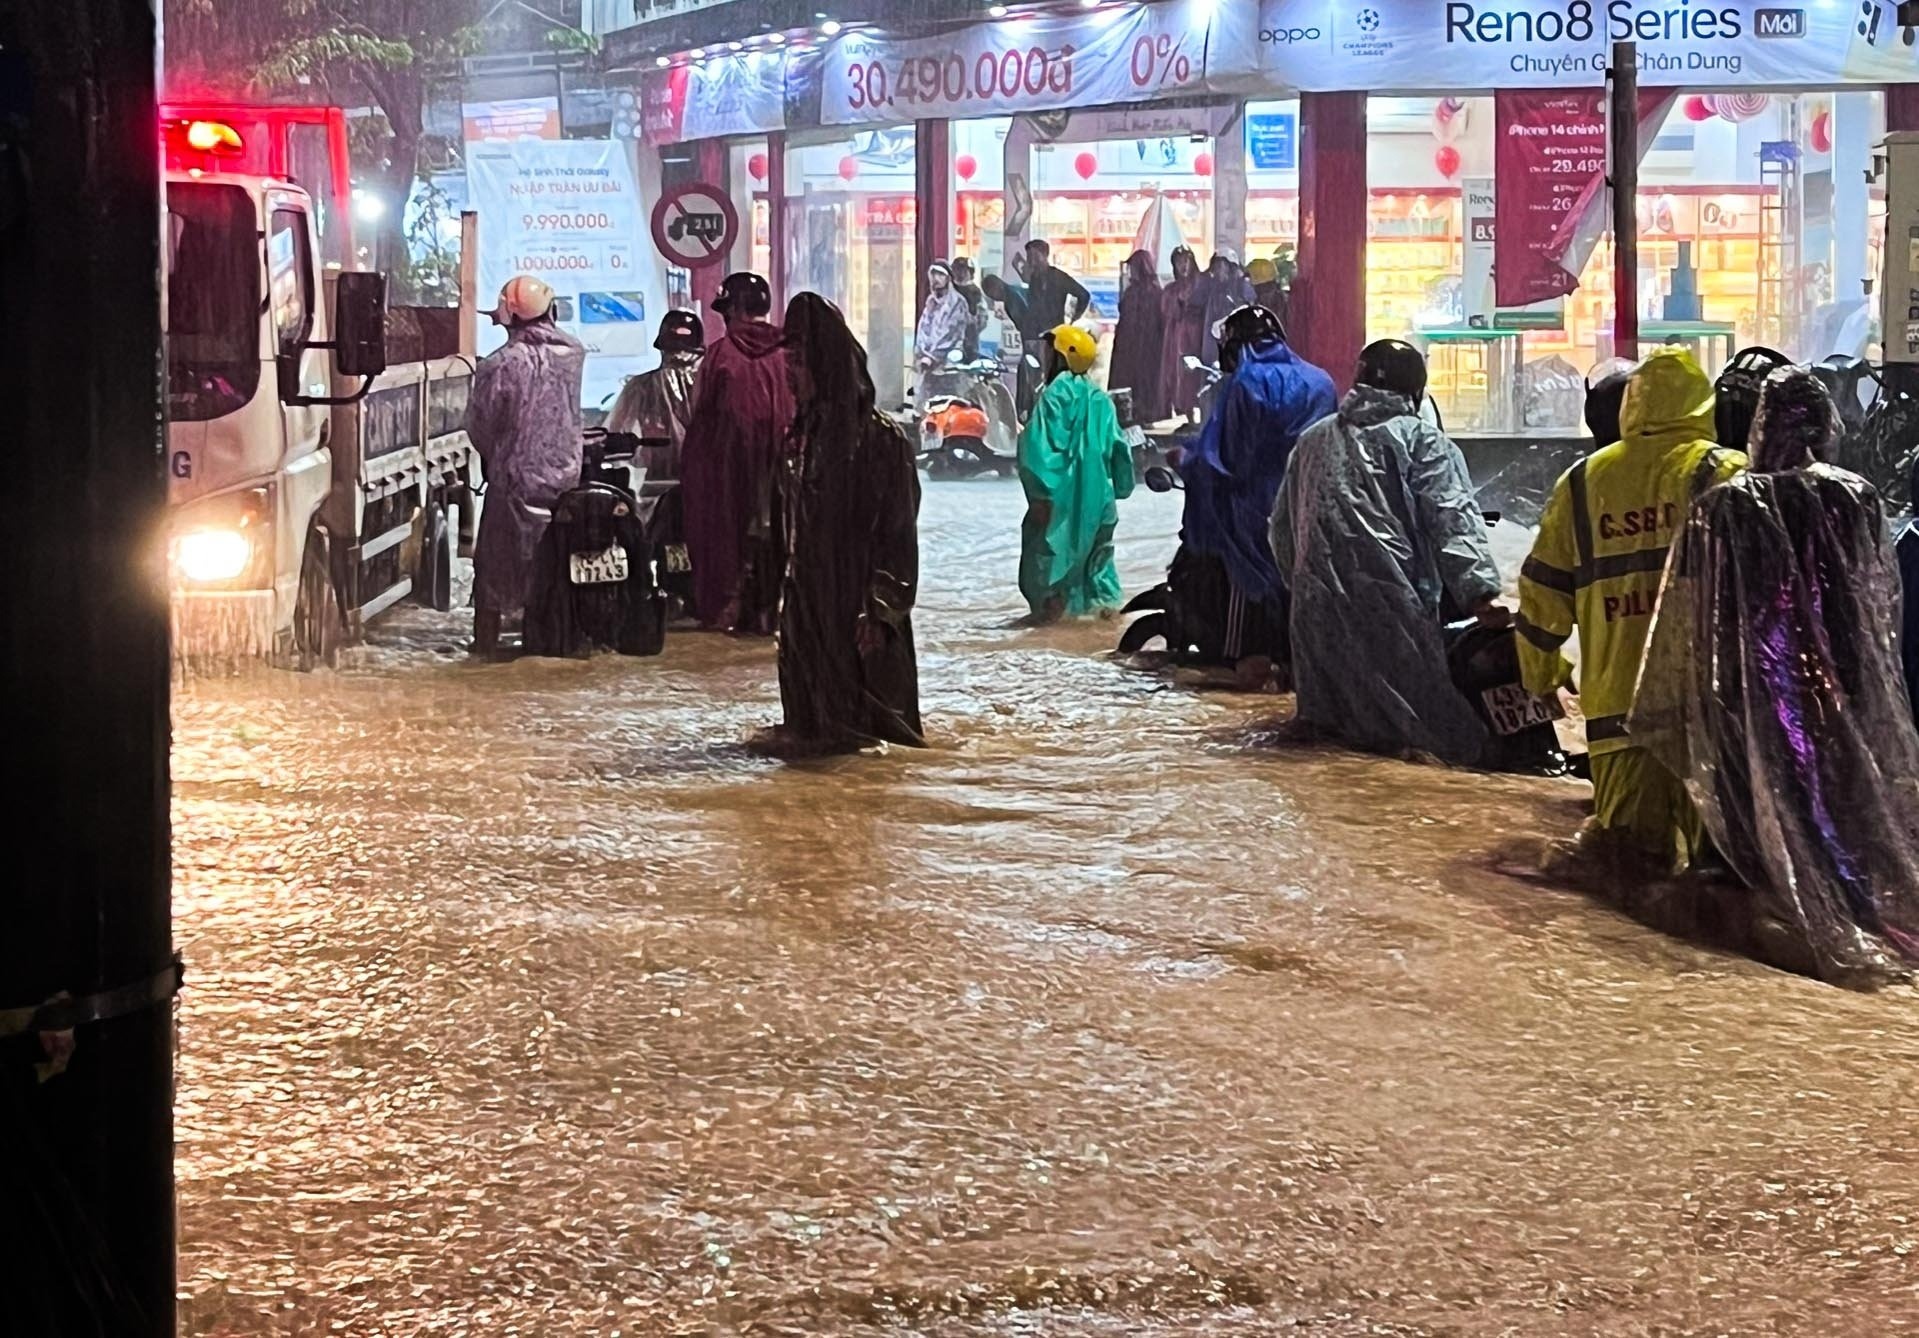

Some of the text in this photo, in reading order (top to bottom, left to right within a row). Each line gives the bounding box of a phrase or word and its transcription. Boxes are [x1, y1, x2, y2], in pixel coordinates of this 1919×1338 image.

[1258, 27, 1321, 46] oppo
[1446, 0, 1742, 43] Reno8 Series
[1131, 33, 1190, 87] 0%
[1510, 53, 1587, 76] Chuyên
[1687, 51, 1742, 74] Dung
